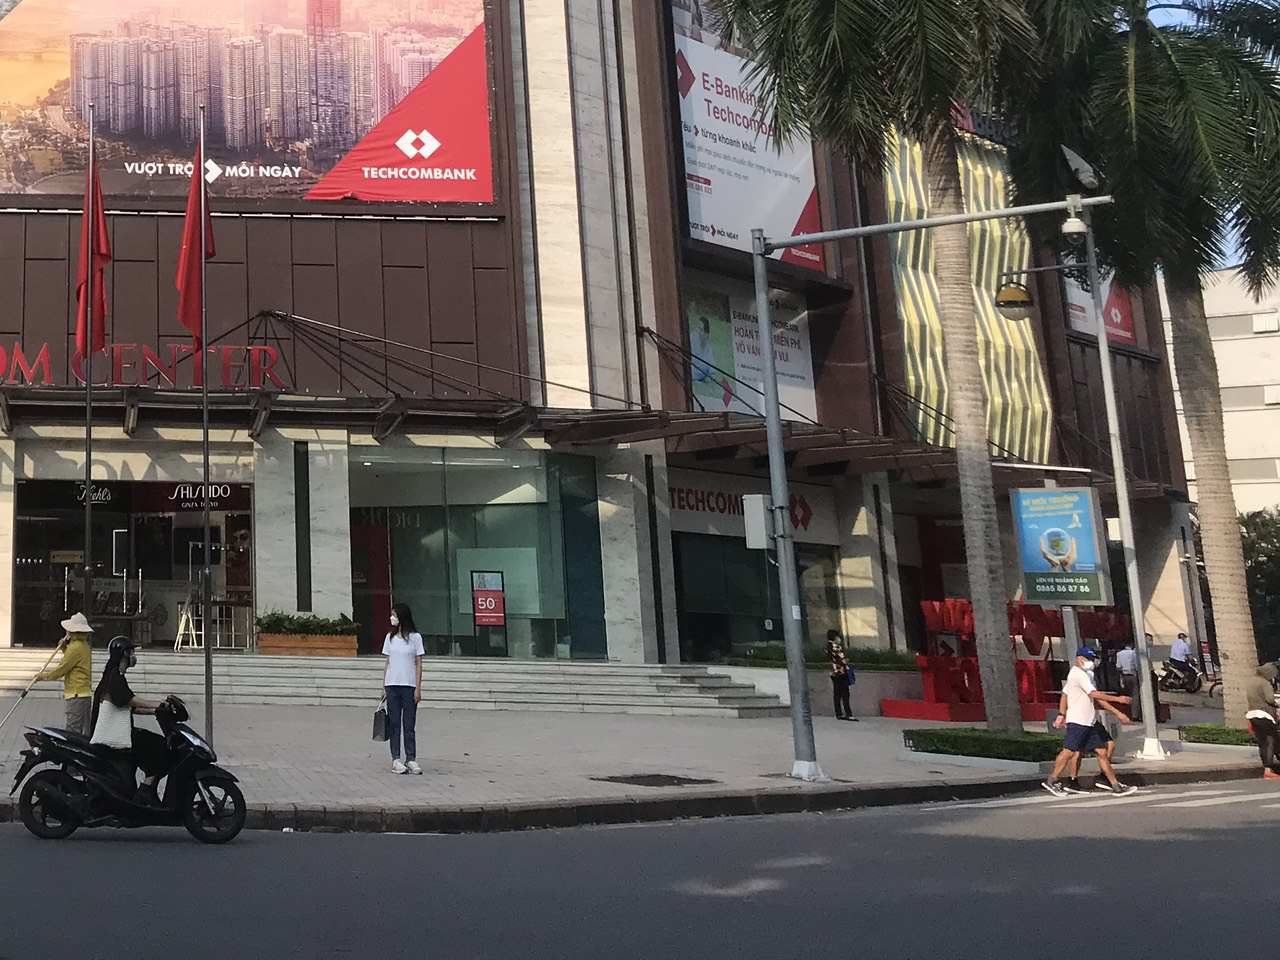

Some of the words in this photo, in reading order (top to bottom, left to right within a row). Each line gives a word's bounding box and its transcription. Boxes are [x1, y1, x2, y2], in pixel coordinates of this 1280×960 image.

[124, 161, 164, 177] VƯỢT
[167, 162, 195, 178] TRỘ
[224, 160, 255, 178] MỖI
[259, 162, 303, 179] NGÀY
[361, 166, 477, 181] TECHCOMBANK
[71, 342, 292, 390] CENTER
[670, 486, 744, 516] TECHCOM
